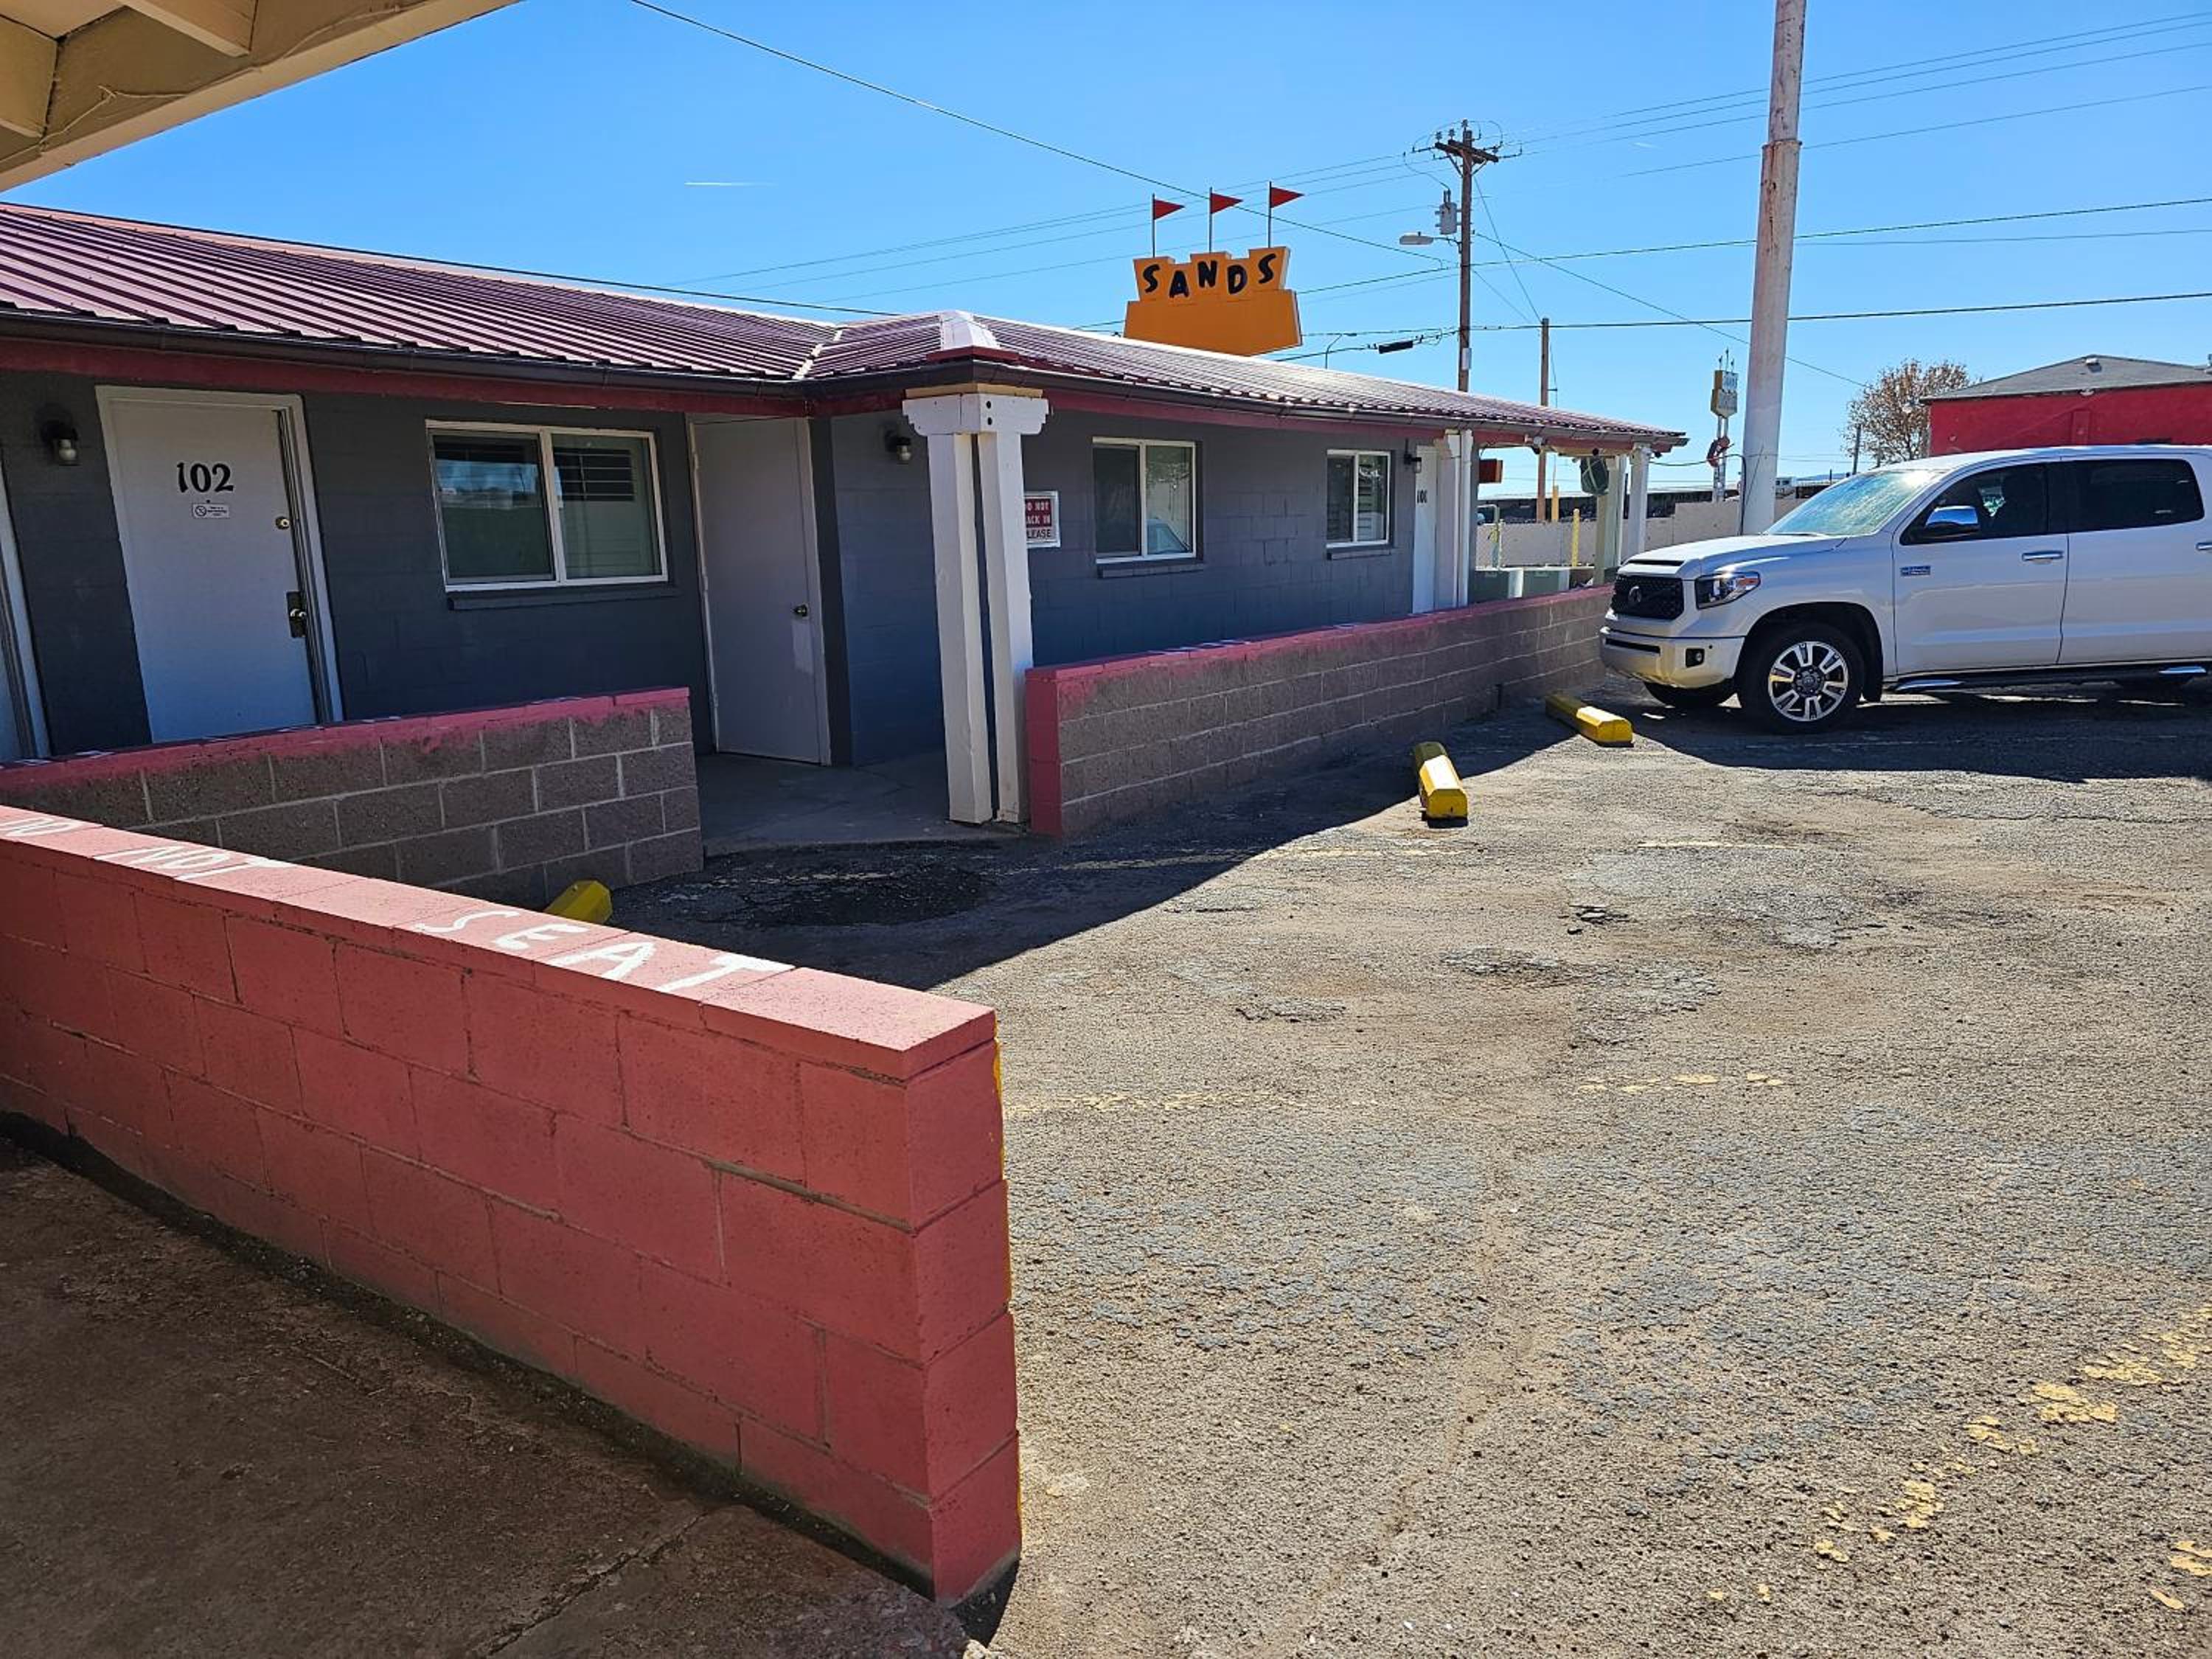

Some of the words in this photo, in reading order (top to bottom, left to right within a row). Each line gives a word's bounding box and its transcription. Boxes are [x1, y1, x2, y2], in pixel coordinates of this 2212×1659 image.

[1142, 253, 1277, 299] SANDS
[177, 462, 234, 493] 102
[1026, 515, 1040, 524] ACK
[1026, 529, 1051, 539] LEASE
[92, 846, 297, 882] NOT
[412, 911, 797, 992] SEAT
